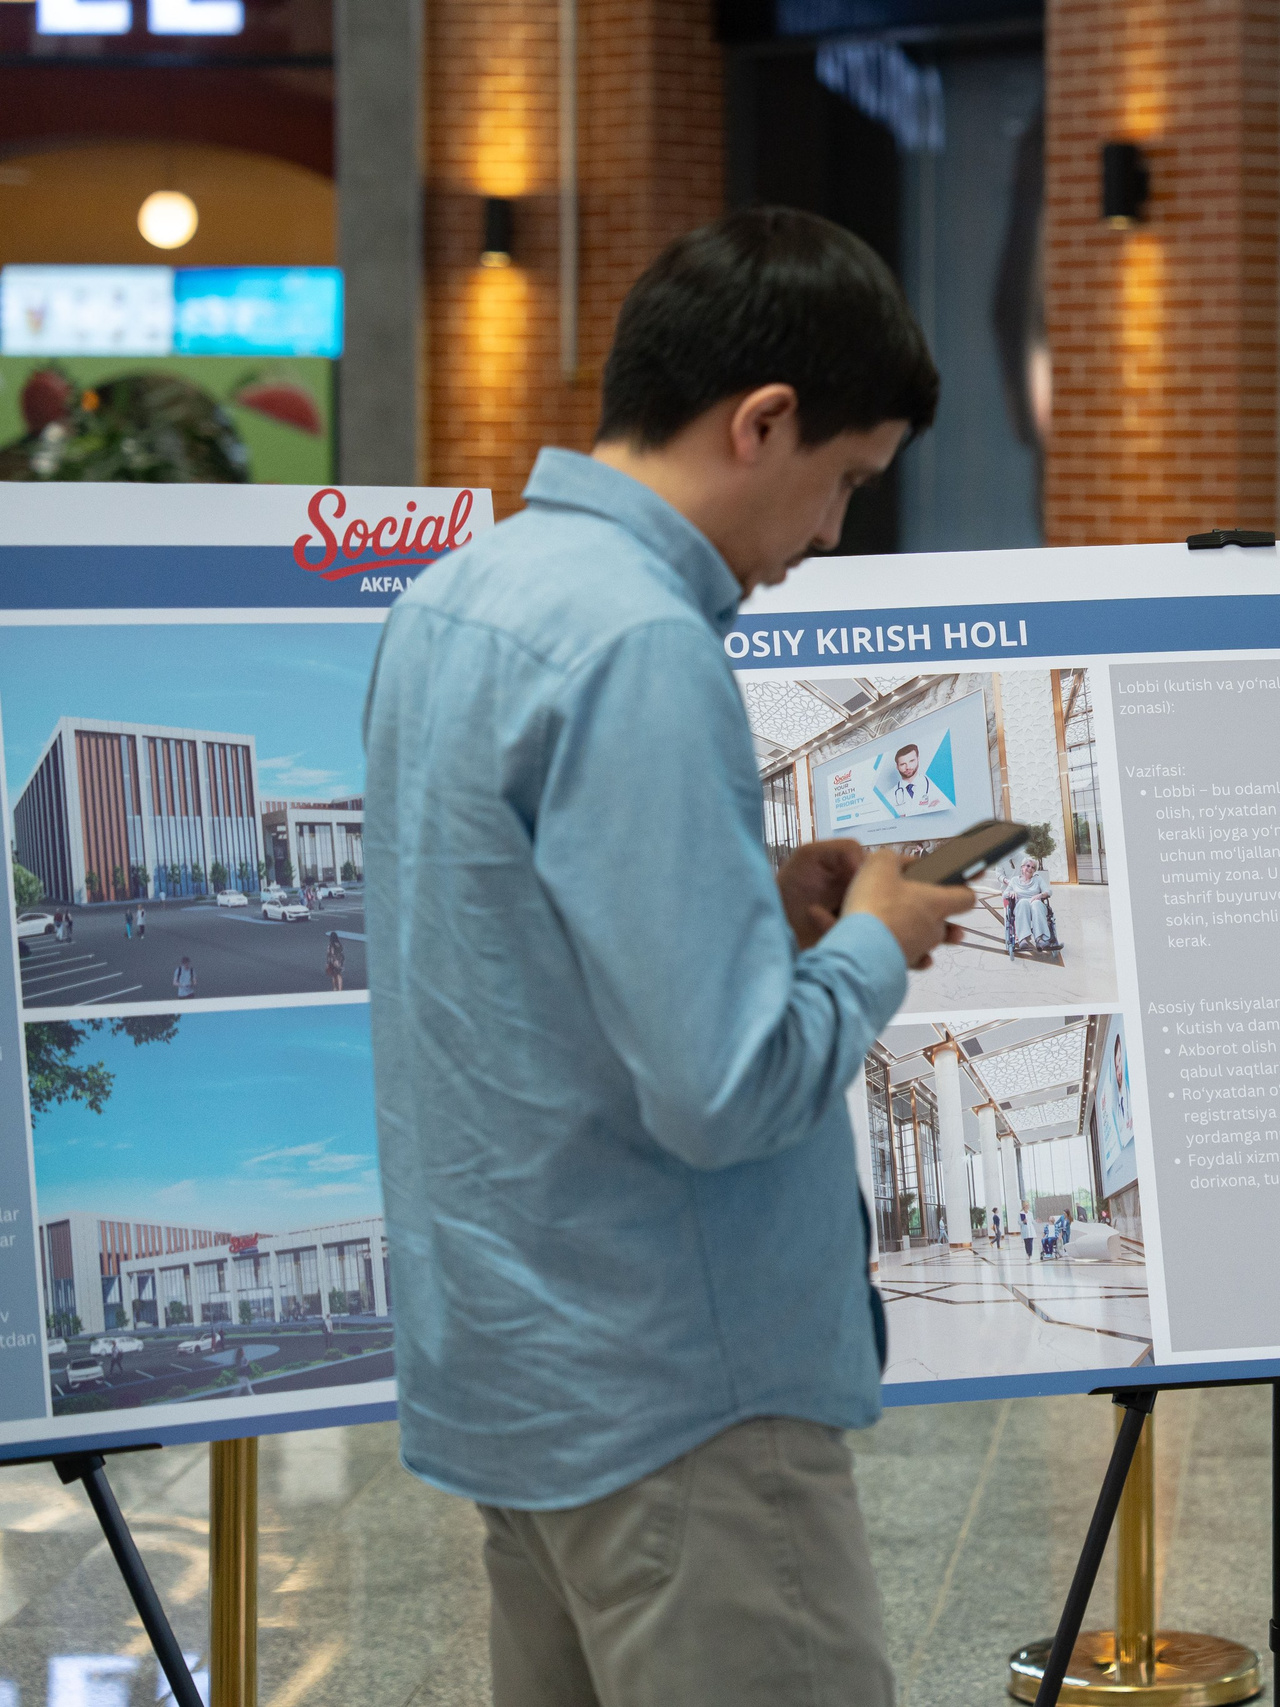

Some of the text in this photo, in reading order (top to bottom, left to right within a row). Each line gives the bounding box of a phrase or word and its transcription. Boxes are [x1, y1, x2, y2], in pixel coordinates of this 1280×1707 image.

[293, 488, 473, 571] Social
[360, 576, 404, 592] AKFA
[724, 619, 1028, 659] OSIY KIRISH HOLI
[1118, 680, 1159, 694] Lobbi
[1164, 679, 1212, 693] (kutish
[1216, 680, 1233, 690] va
[1120, 701, 1174, 715] zonasi):
[1125, 764, 1185, 778] Vazifasi:
[1154, 784, 1195, 798] Lobbi
[1212, 784, 1230, 796] bu
[1156, 806, 1195, 820] olish,
[1158, 827, 1205, 840] kerakli
[1209, 826, 1248, 842] joyga
[1160, 849, 1205, 862] uchun
[1162, 869, 1221, 885] umumiy
[1226, 870, 1263, 881] zona.
[1268, 867, 1277, 879] U
[1164, 890, 1212, 905] tashrif
[1166, 913, 1208, 927] sokin,
[1213, 910, 1278, 924] ishonchli
[1168, 934, 1211, 947] kerak.
[1148, 1000, 1195, 1016] Asosiy
[1176, 1020, 1222, 1034] Kutish
[1227, 1022, 1244, 1032] va
[1248, 1019, 1280, 1031] dam
[1178, 1043, 1238, 1056] Axborot
[1242, 1040, 1276, 1053] olish
[1180, 1064, 1222, 1081] qabul
[1184, 1106, 1277, 1125] registratsiya
[1186, 1130, 1261, 1148] yordamga
[1188, 1151, 1242, 1169] Foydali
[1190, 1175, 1260, 1189] dorixona,
